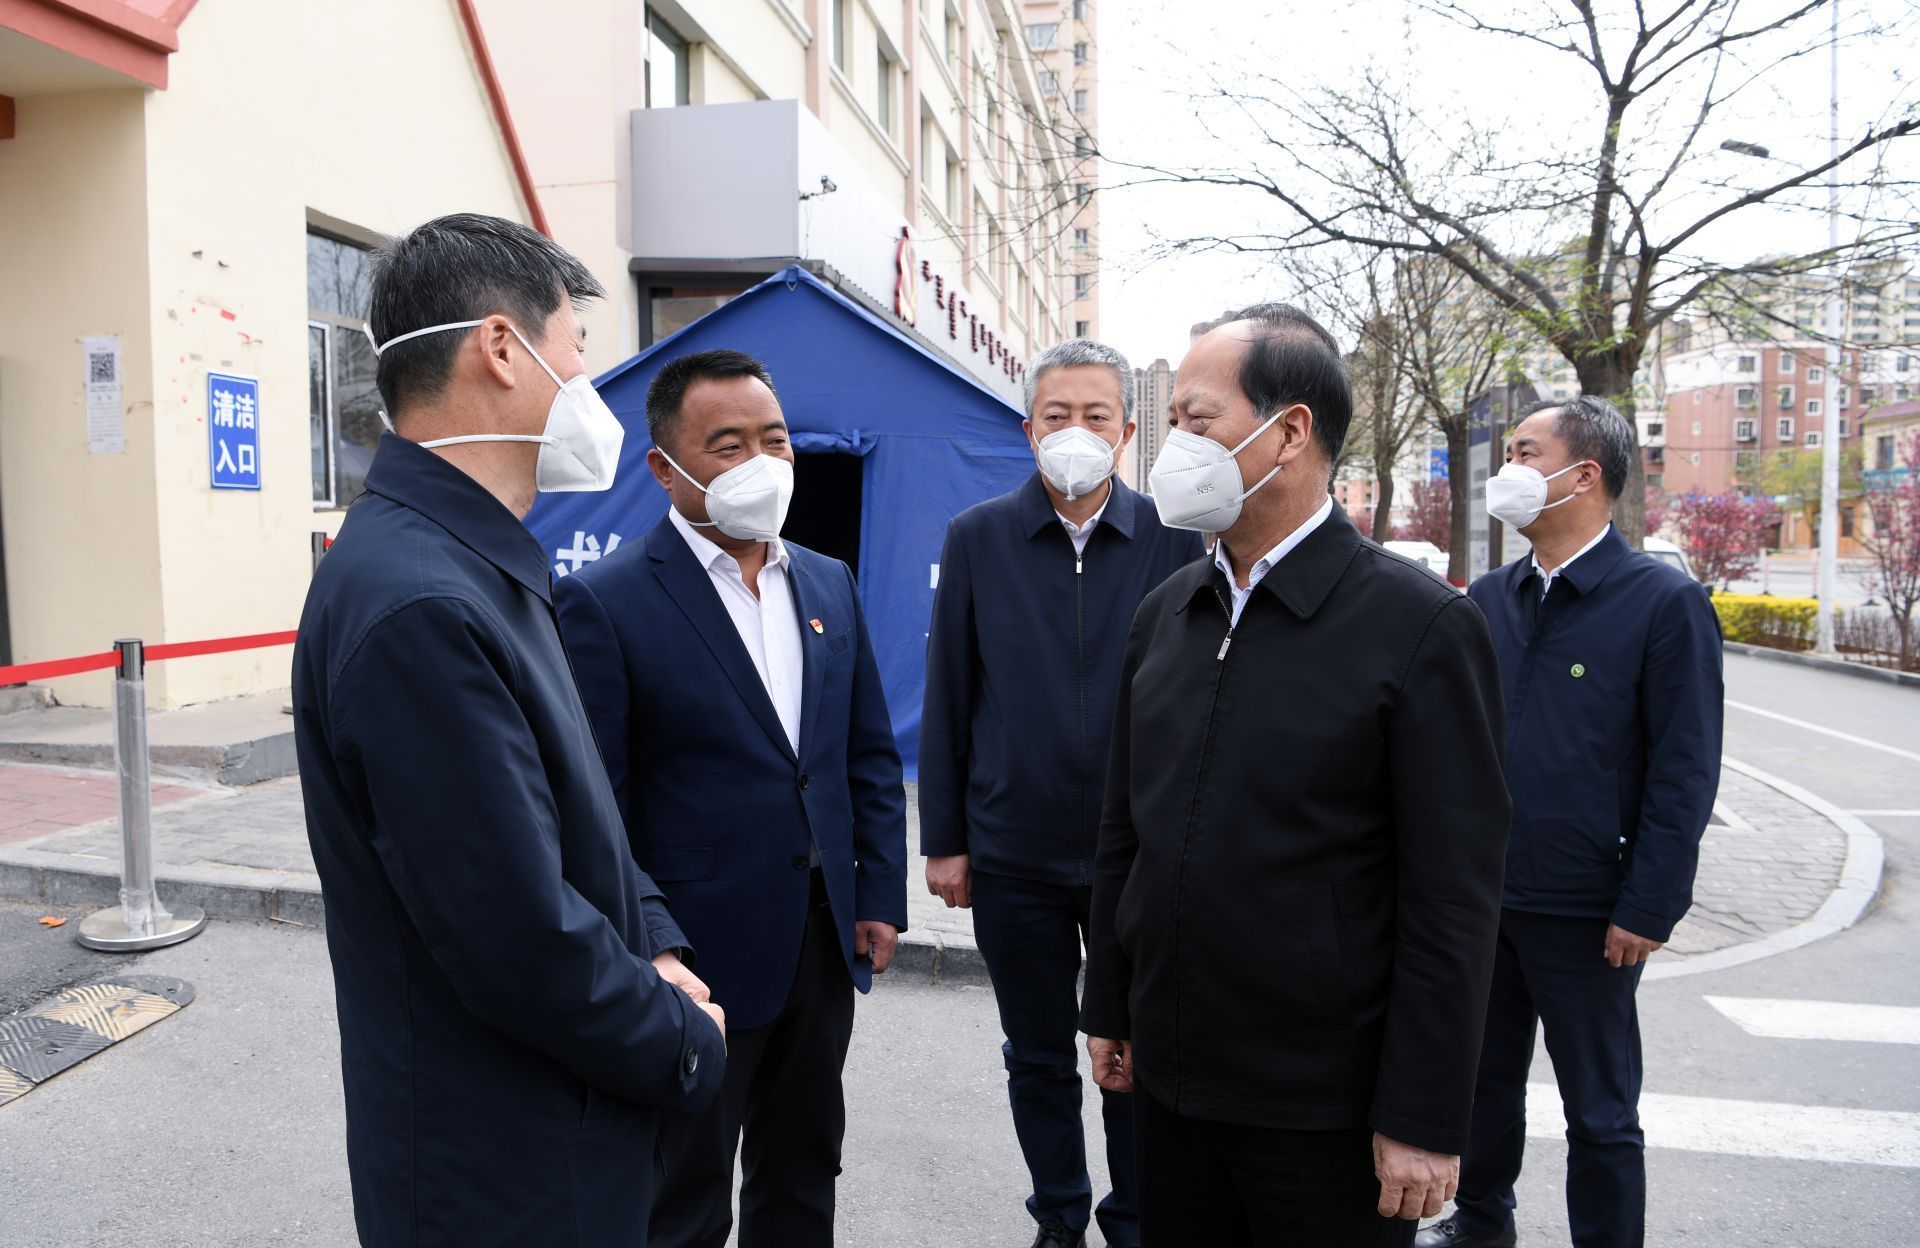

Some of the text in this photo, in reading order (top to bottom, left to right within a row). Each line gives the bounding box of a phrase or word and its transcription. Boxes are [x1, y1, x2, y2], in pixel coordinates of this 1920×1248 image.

[213, 389, 255, 429] 清洁
[216, 438, 255, 474] 入口
[1196, 483, 1214, 495] N95
